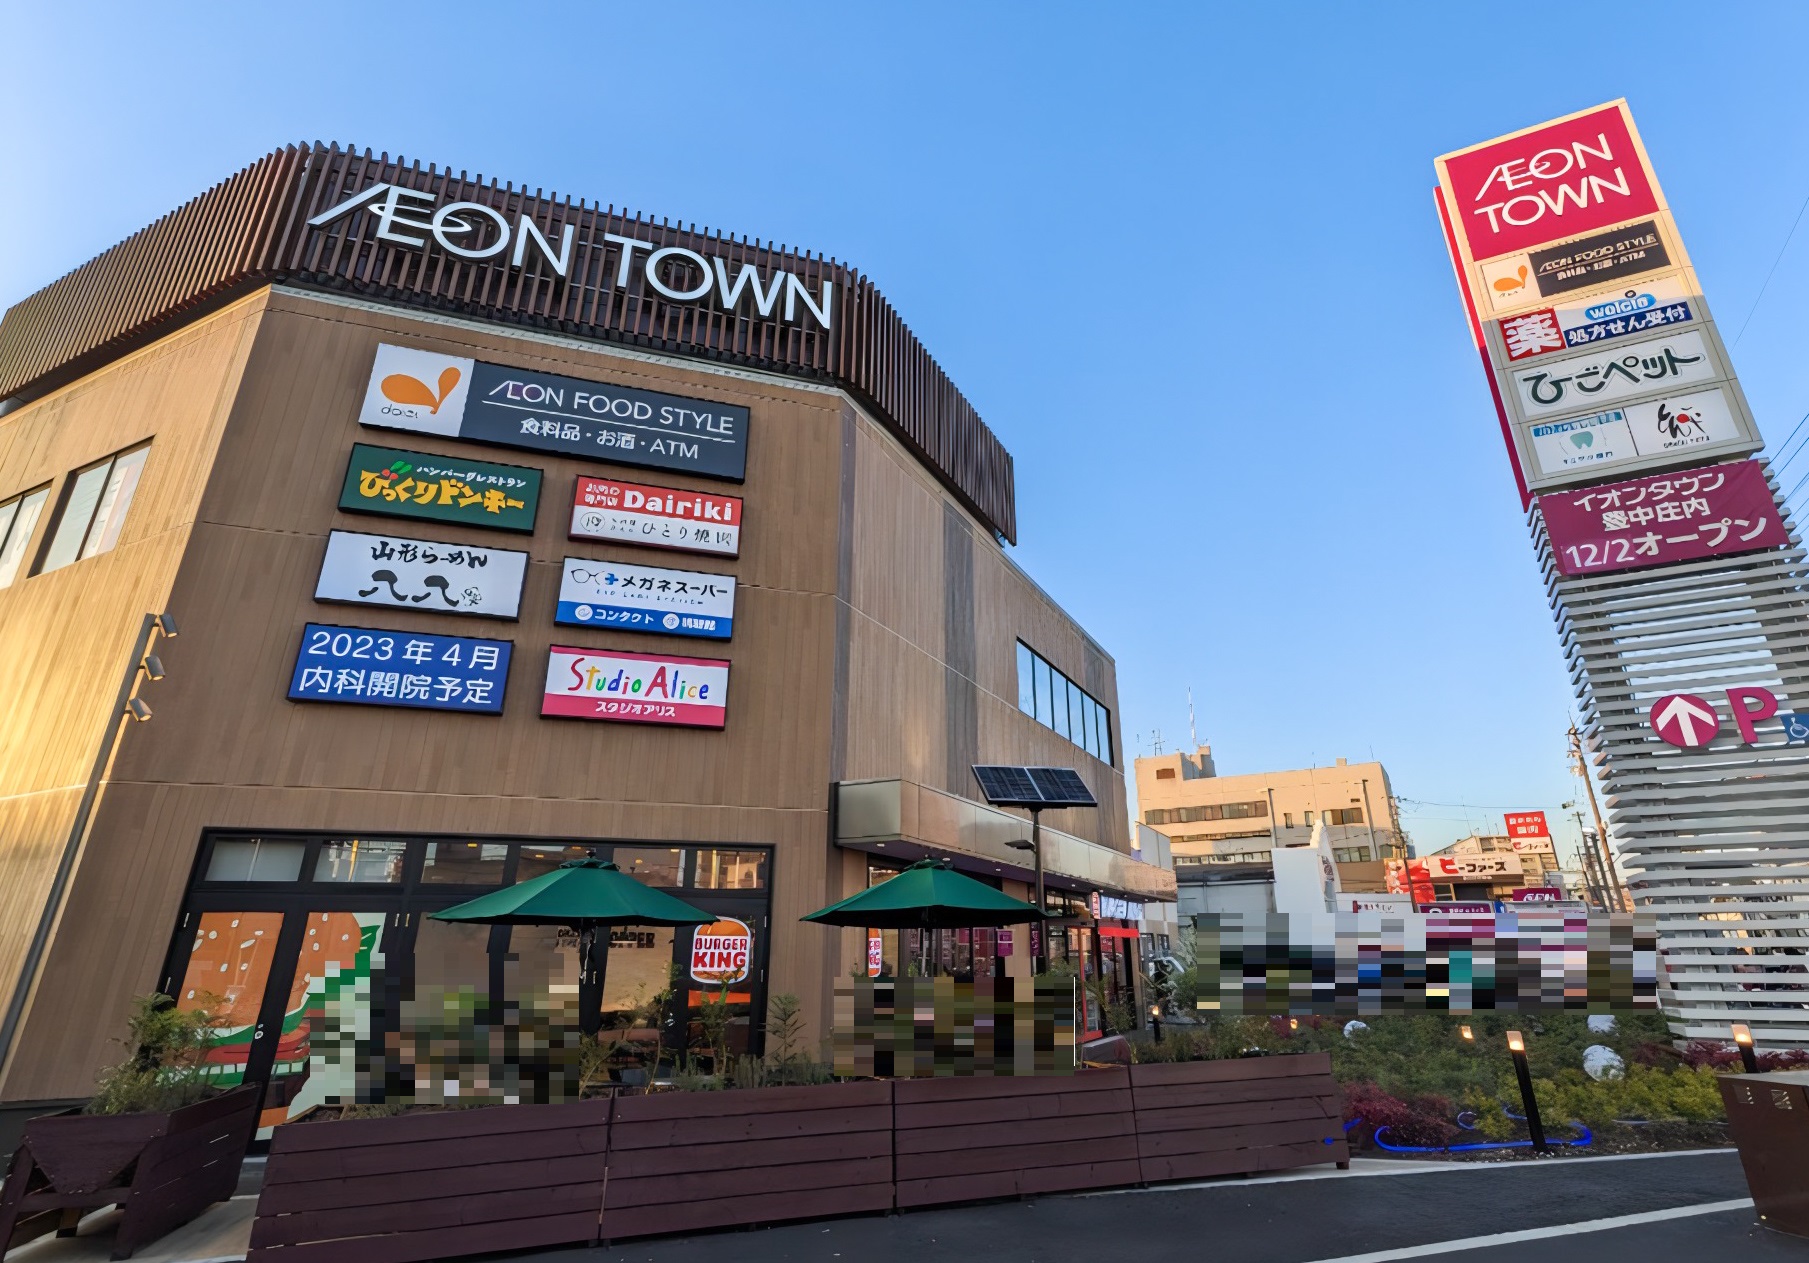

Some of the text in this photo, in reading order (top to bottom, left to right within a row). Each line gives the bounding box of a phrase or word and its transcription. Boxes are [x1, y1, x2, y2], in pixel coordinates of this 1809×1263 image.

[1474, 167, 1631, 234] TOWN
[603, 233, 832, 330] TOWN
[1503, 312, 1562, 358] 薬
[1522, 347, 1701, 404] ひごペット
[573, 392, 652, 420] FOOD
[659, 406, 734, 435] STYLE
[358, 469, 525, 514] びっくりドンキー
[623, 489, 733, 522] Dairiki
[1574, 472, 1726, 512] イオンタウン
[370, 540, 488, 569] 山形らーめん
[1566, 517, 1768, 568] 12/2オープン
[298, 665, 495, 705] 内科開院予定
[567, 656, 710, 701] Studio Alice
[1726, 686, 1779, 744] P
[691, 950, 747, 969] KING
[693, 937, 748, 951] BURGER
